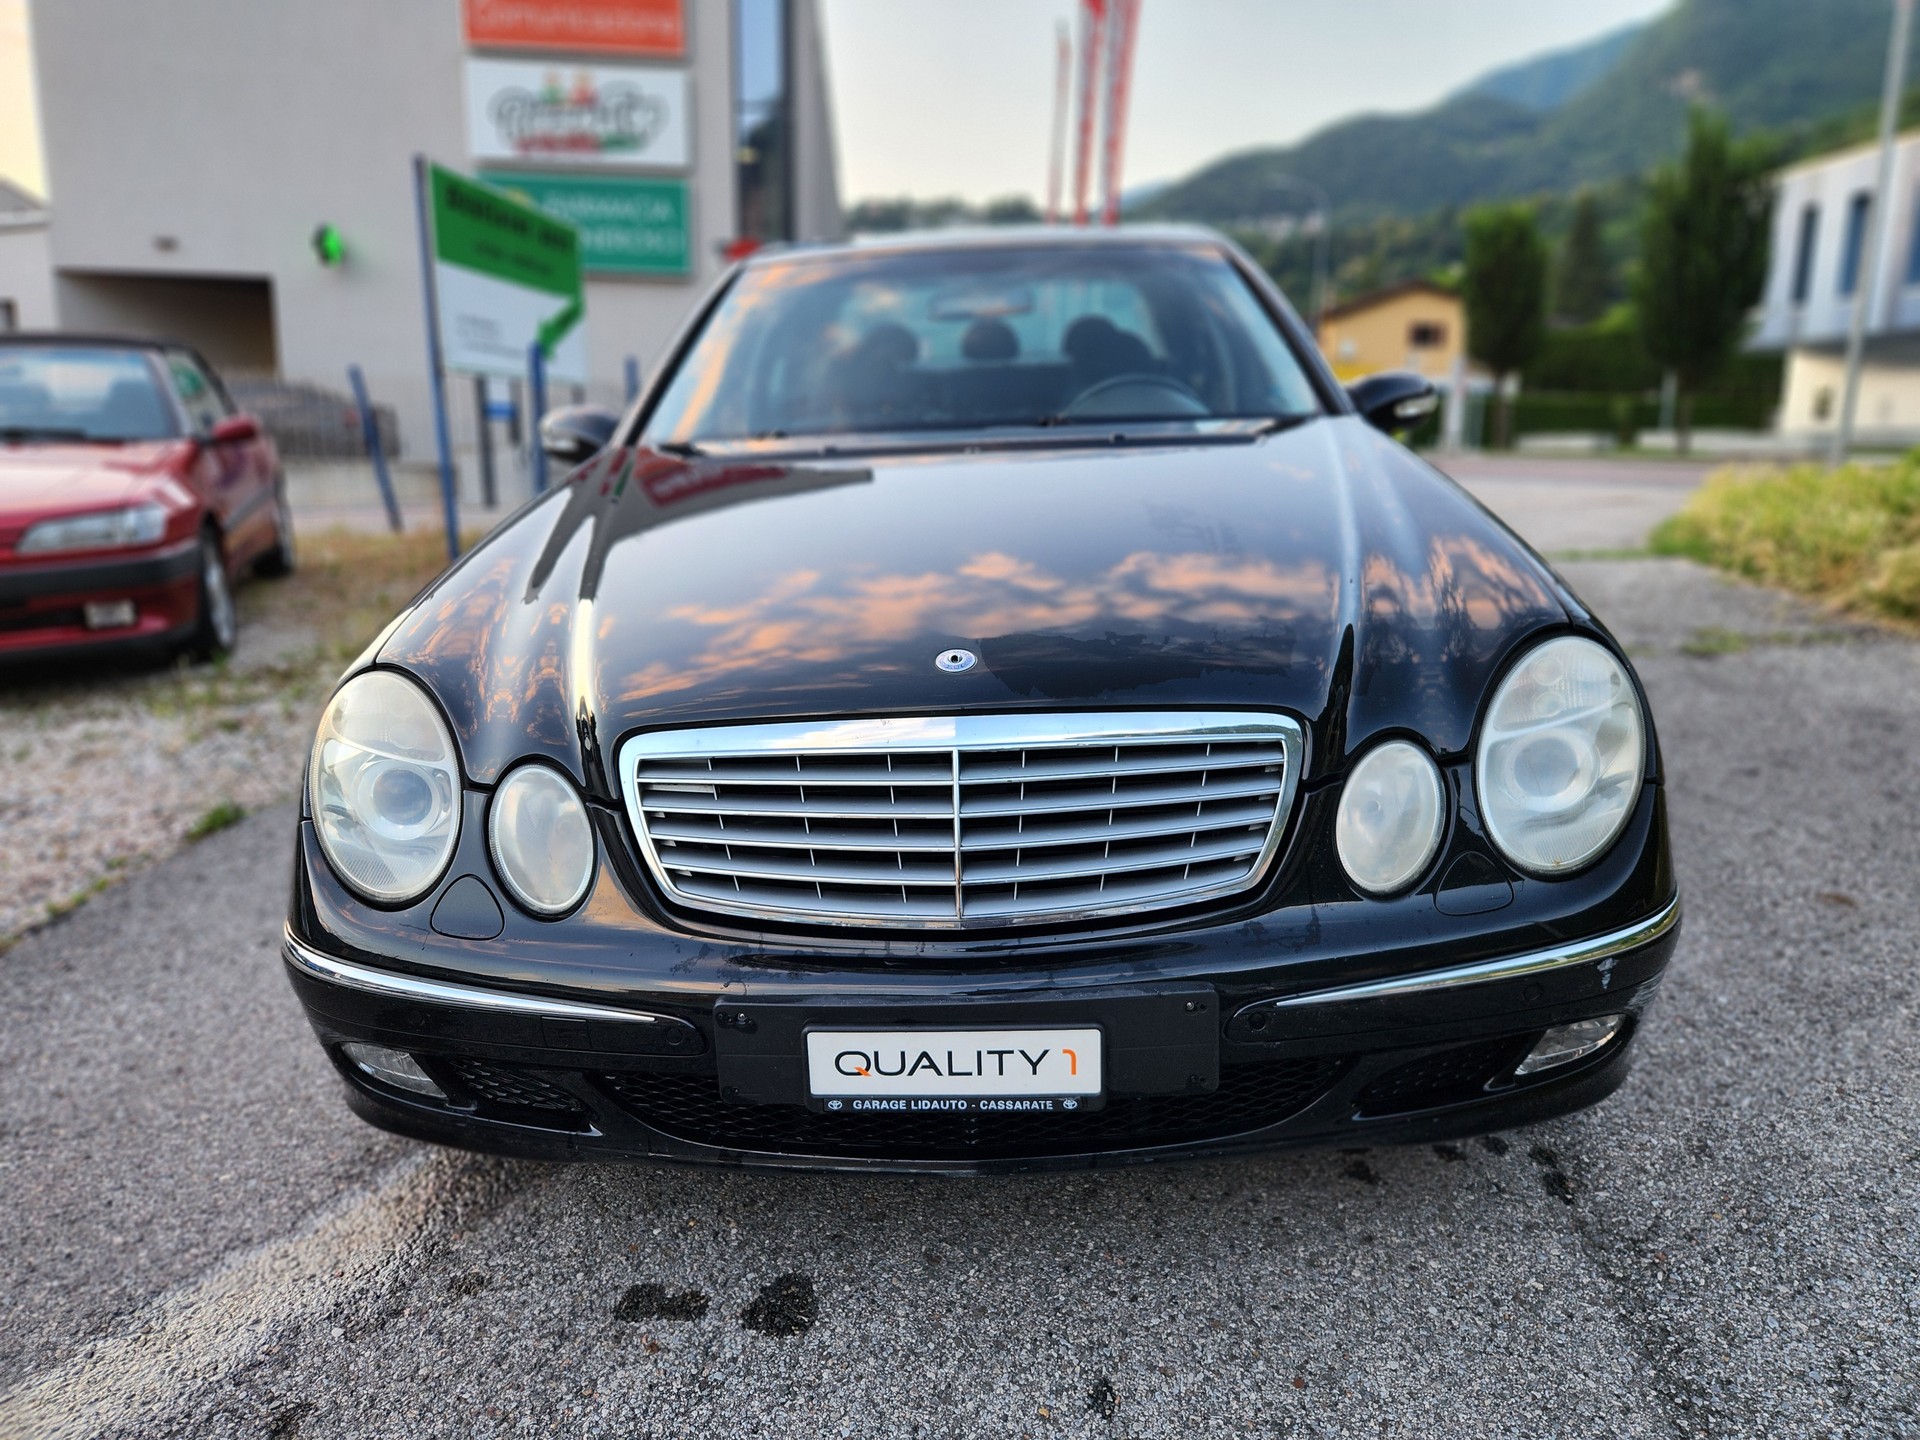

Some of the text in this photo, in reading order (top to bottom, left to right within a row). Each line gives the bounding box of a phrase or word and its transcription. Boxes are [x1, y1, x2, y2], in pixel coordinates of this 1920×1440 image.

[834, 1048, 1077, 1077] QUALITY 1
[852, 1099, 907, 1110] GARAGE
[911, 1099, 968, 1110] LIDAUTO
[979, 1099, 1053, 1111] CASSARATE
